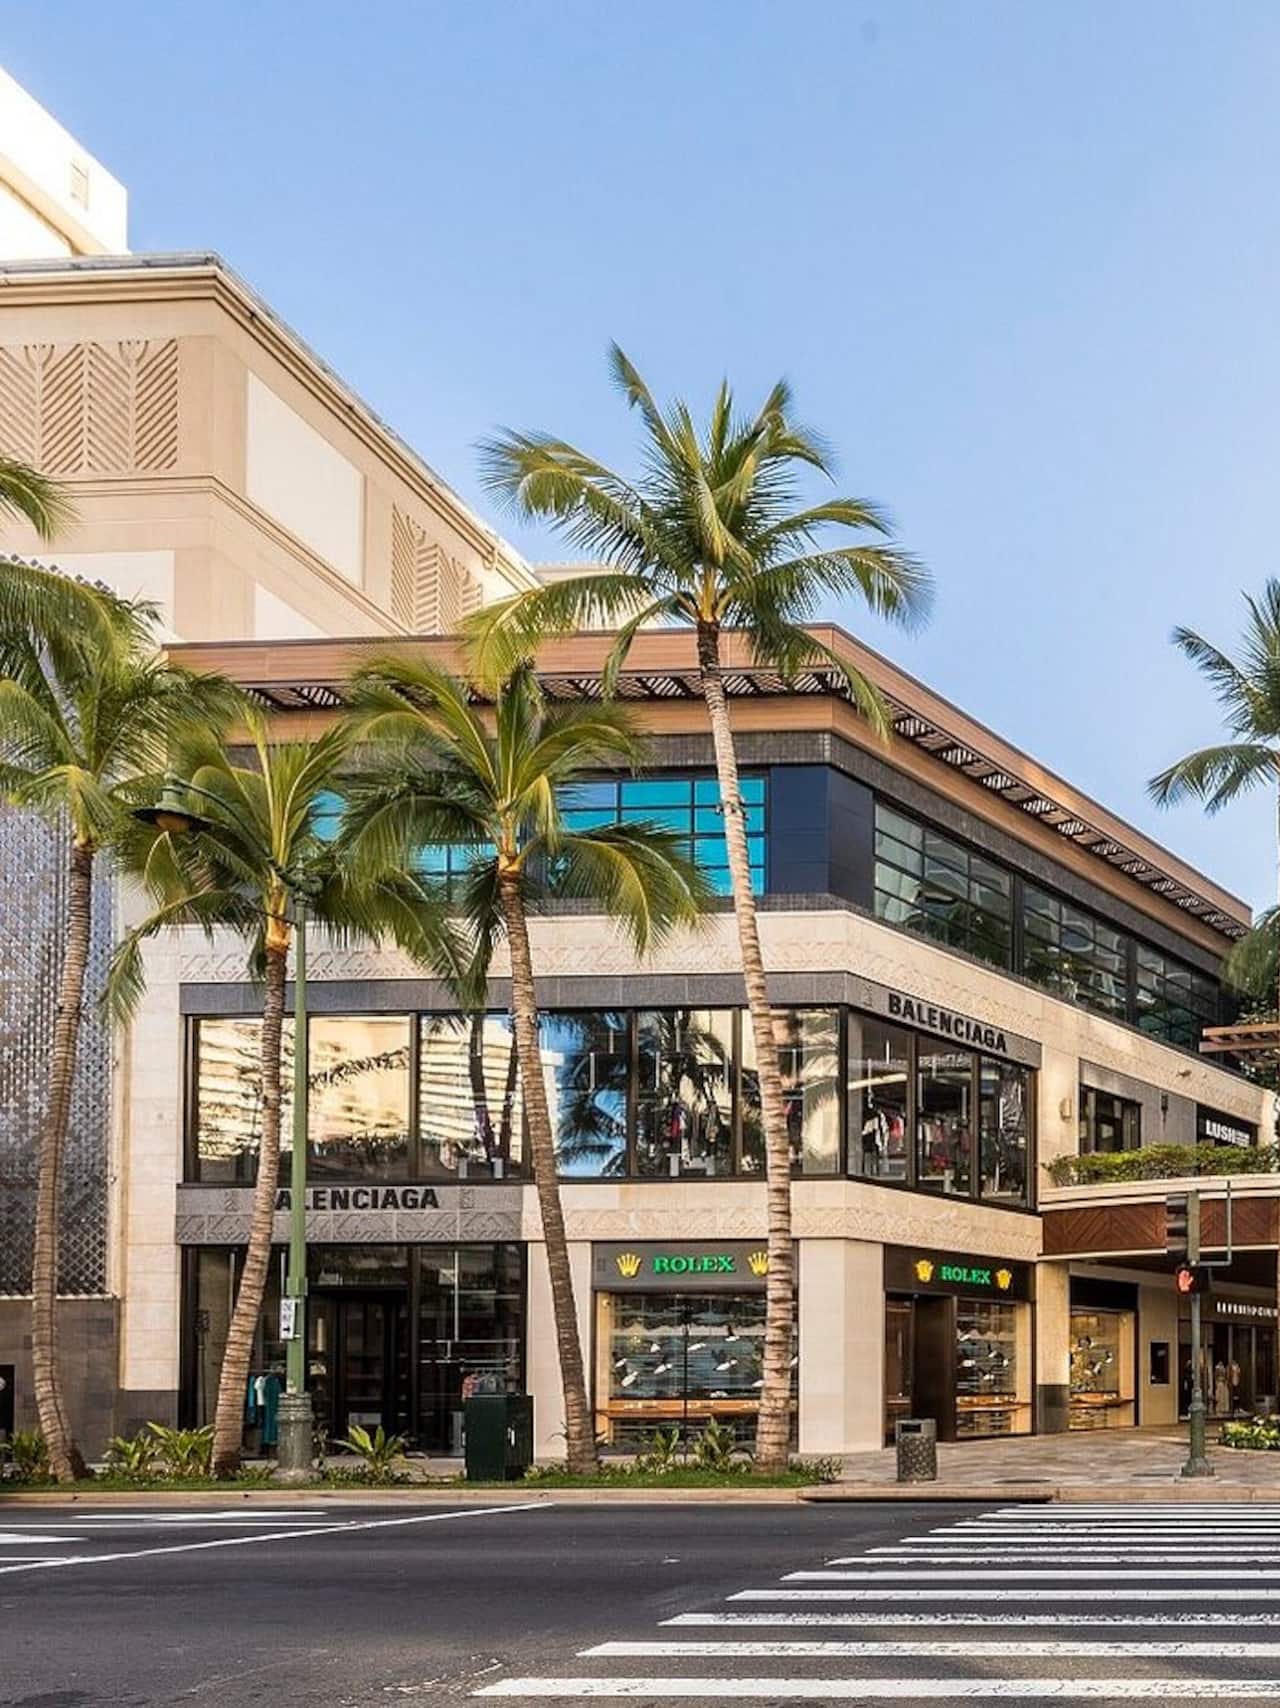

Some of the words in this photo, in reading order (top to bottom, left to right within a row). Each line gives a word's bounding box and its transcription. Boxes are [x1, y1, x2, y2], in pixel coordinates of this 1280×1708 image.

[888, 993, 1006, 1052] BALENCIAGA
[1206, 1120, 1235, 1143] LUSH
[275, 1188, 439, 1210] AENCIAGA
[653, 1256, 736, 1274] ROLEX
[941, 1266, 992, 1285] ROLEX
